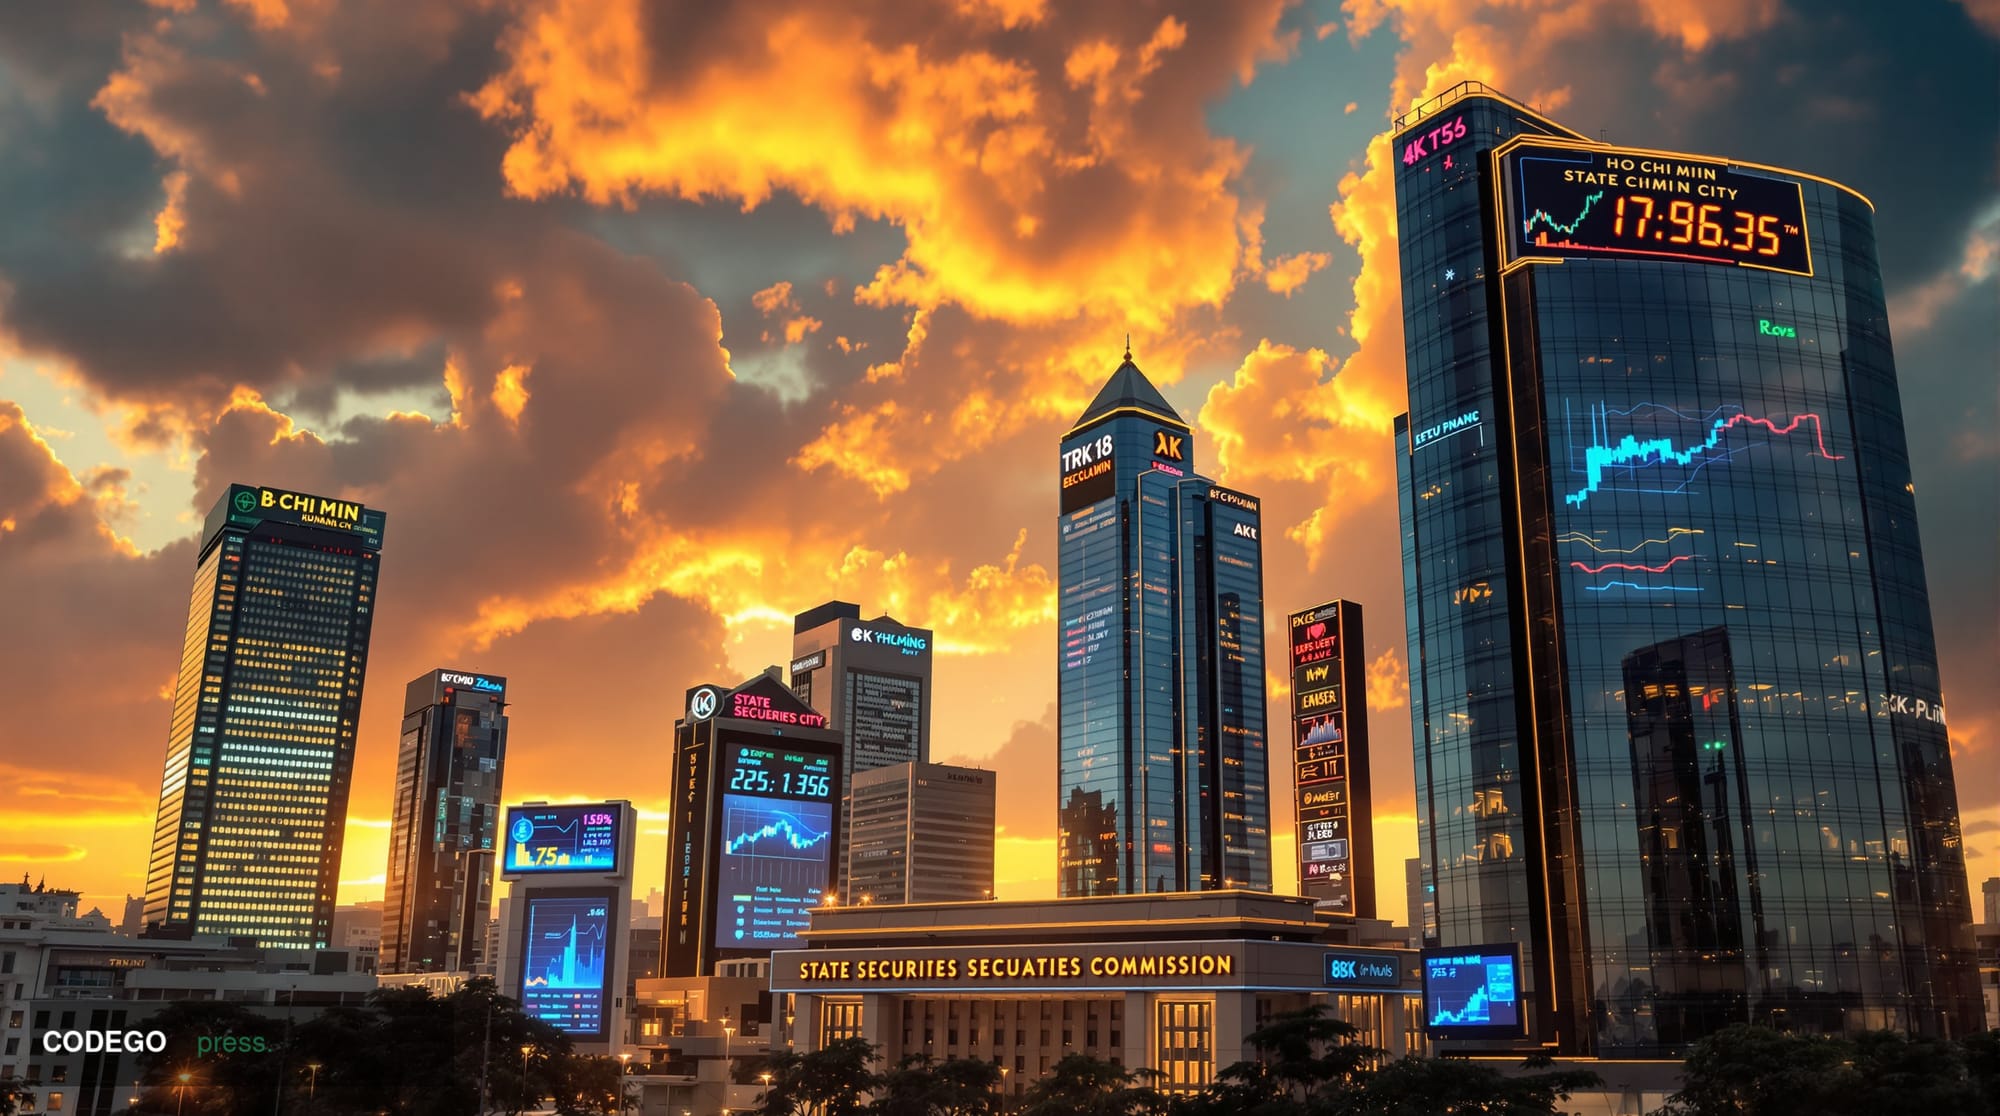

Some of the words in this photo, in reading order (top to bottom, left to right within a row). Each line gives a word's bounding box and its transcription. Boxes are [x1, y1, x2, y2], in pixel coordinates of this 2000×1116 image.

[1606, 158, 1635, 172] HO
[1640, 161, 1671, 175] CHI
[1563, 170, 1618, 186] STATE
[1697, 184, 1738, 201] CITY
[1613, 196, 1780, 256] 17:96.35
[1061, 442, 1092, 472] TRK
[1095, 434, 1113, 460] 18
[320, 499, 359, 522] MIN
[734, 693, 771, 709] STATE
[799, 713, 824, 727] CITY
[799, 961, 851, 980] STATE
[967, 956, 1082, 978] SECUATIES
[1090, 954, 1232, 976] COMMISSION
